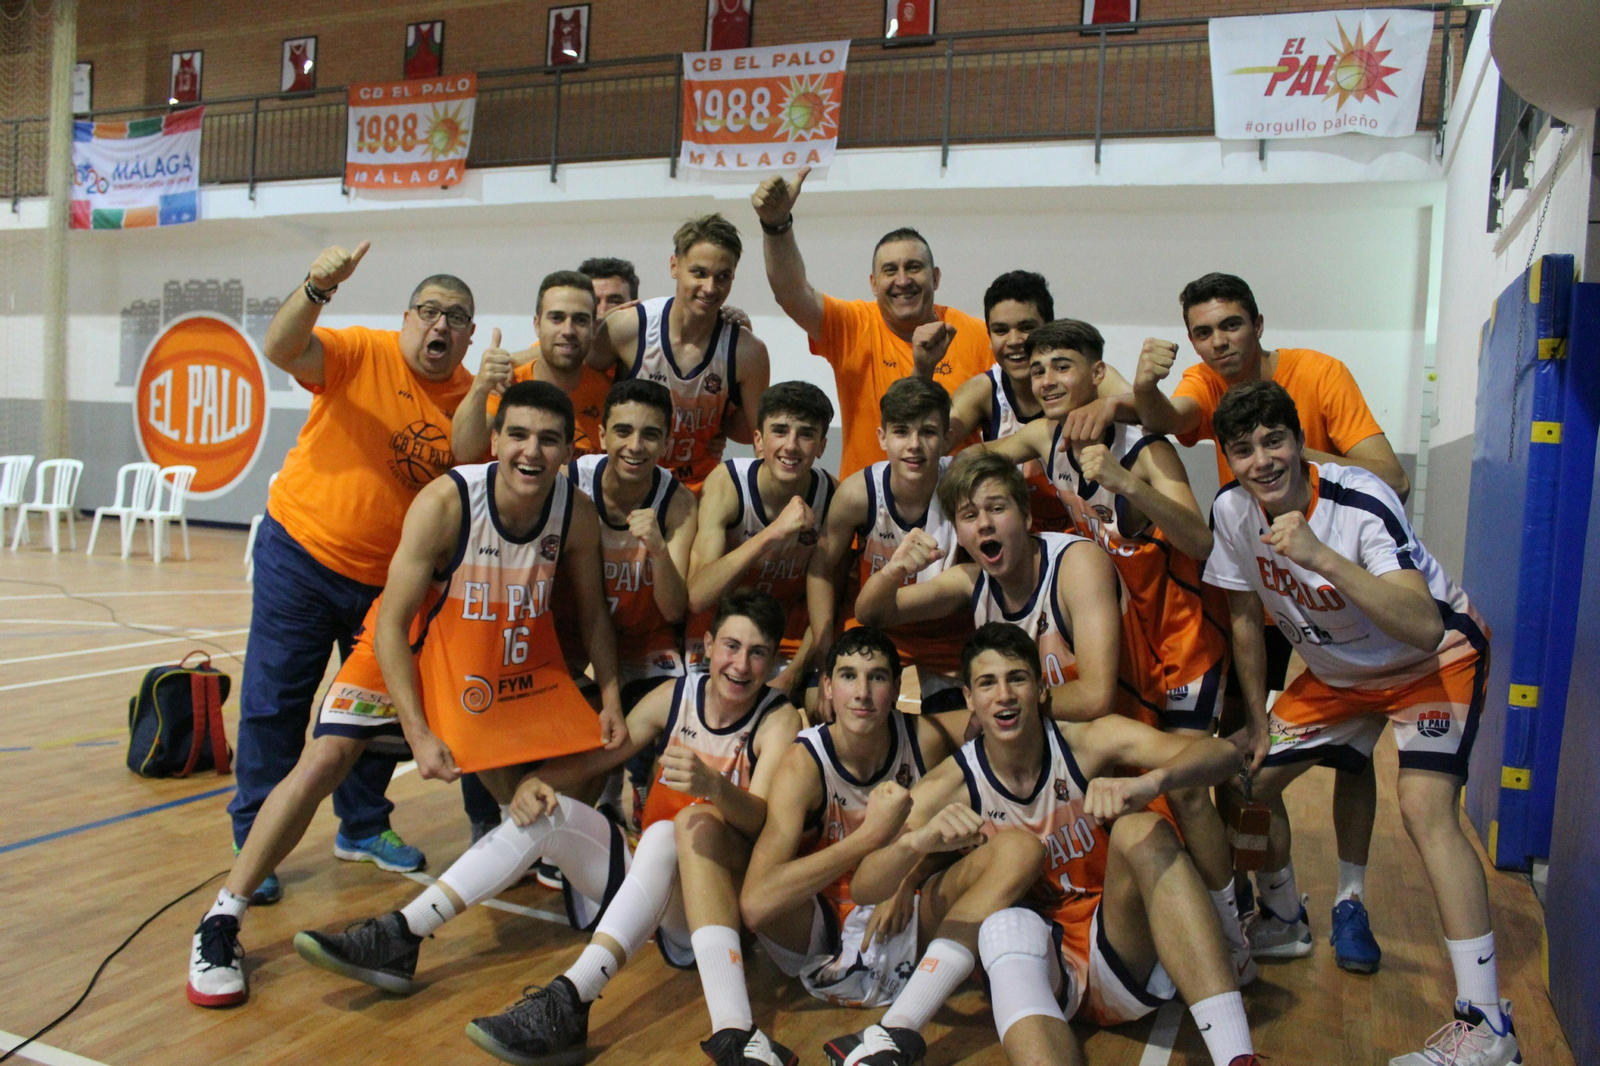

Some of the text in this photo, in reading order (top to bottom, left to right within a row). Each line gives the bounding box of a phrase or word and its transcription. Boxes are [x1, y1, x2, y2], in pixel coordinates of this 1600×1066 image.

[1282, 37, 1306, 55] EL
[692, 49, 836, 73] CB EL PALO
[360, 78, 471, 100] CB EL PALO
[694, 86, 772, 134] 1988
[356, 112, 419, 154] 1988
[1245, 113, 1379, 136] #orgullo paleño
[112, 151, 193, 181] MÁLAGA
[689, 149, 821, 168] MÁLAGA
[354, 167, 458, 185] MÁLAGA
[148, 364, 252, 445] EL PALO
[392, 432, 409, 453] CB
[461, 580, 497, 621] EL
[503, 625, 530, 667] 16
[498, 674, 534, 695] FYM
[1043, 816, 1096, 871] ALO
